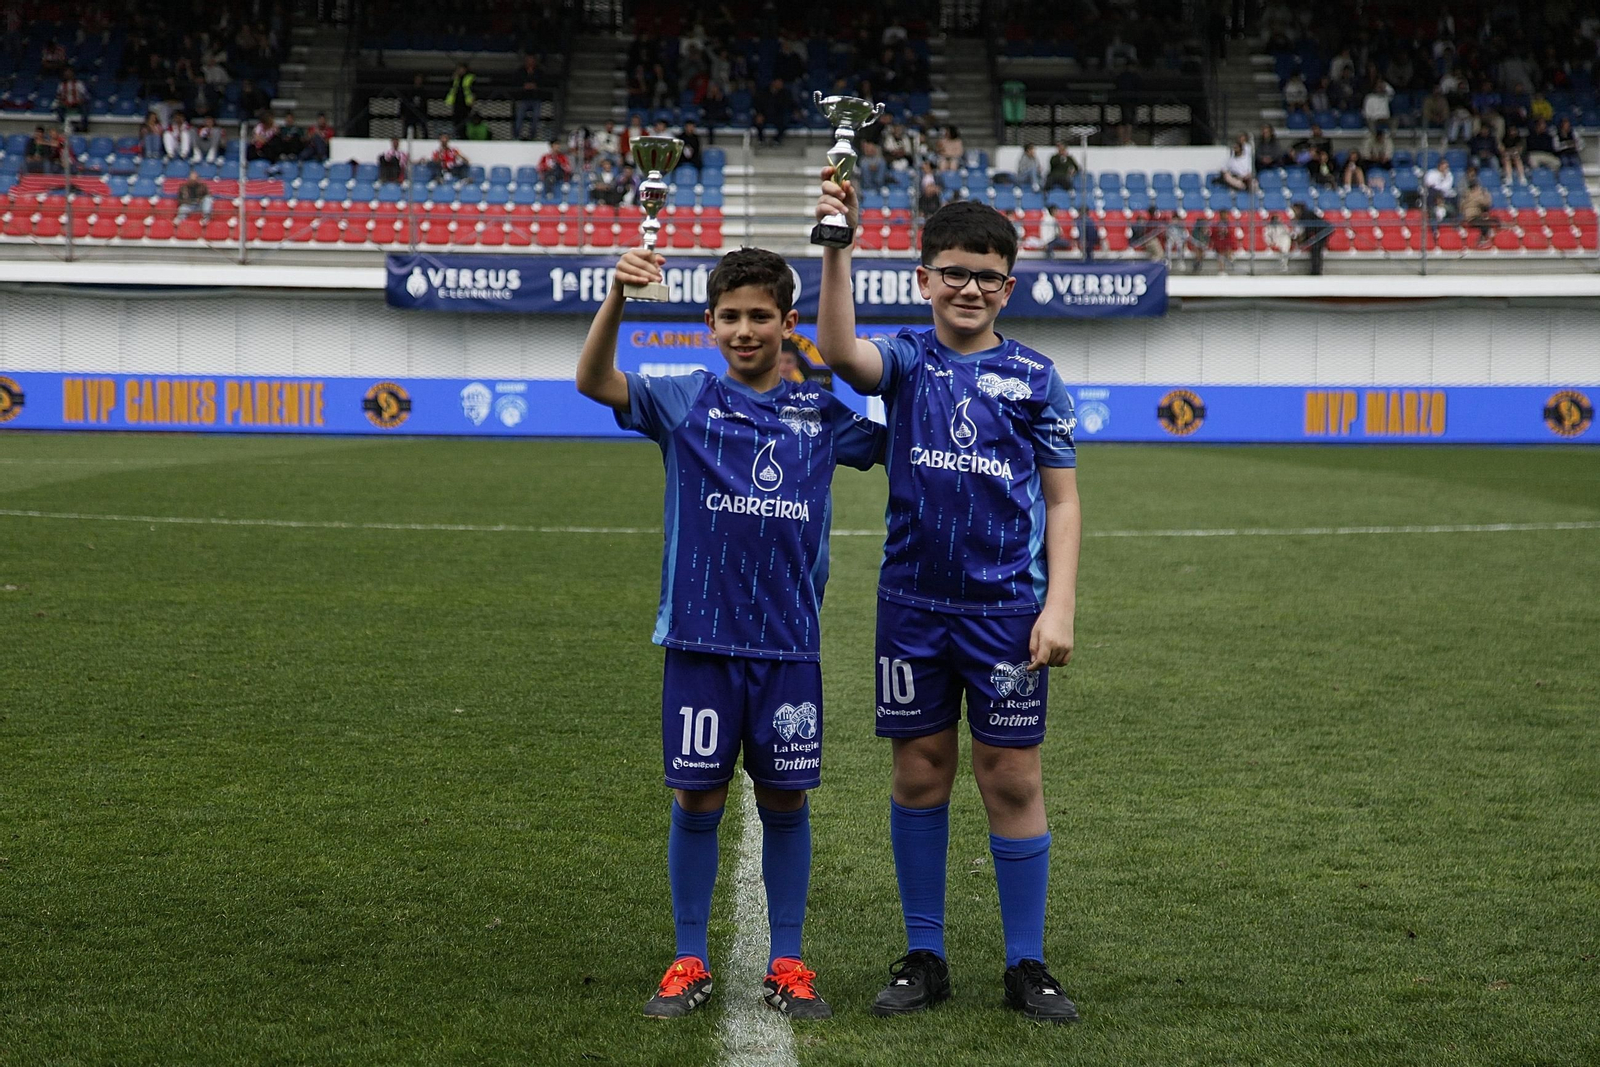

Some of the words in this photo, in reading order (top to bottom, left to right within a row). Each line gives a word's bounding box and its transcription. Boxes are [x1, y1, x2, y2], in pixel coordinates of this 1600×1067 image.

[427, 267, 521, 290] VERSUS
[1053, 273, 1147, 296] VERSUS
[63, 378, 116, 424] MVP
[124, 379, 217, 425] CARNES
[224, 381, 324, 427] PARENTE
[1304, 391, 1357, 436] MVP
[1365, 391, 1447, 437] MARZO
[879, 656, 916, 704] 10
[988, 712, 1039, 727] Ontime
[679, 706, 719, 757] 10
[773, 743, 789, 753] La
[773, 757, 820, 771] Ontime
